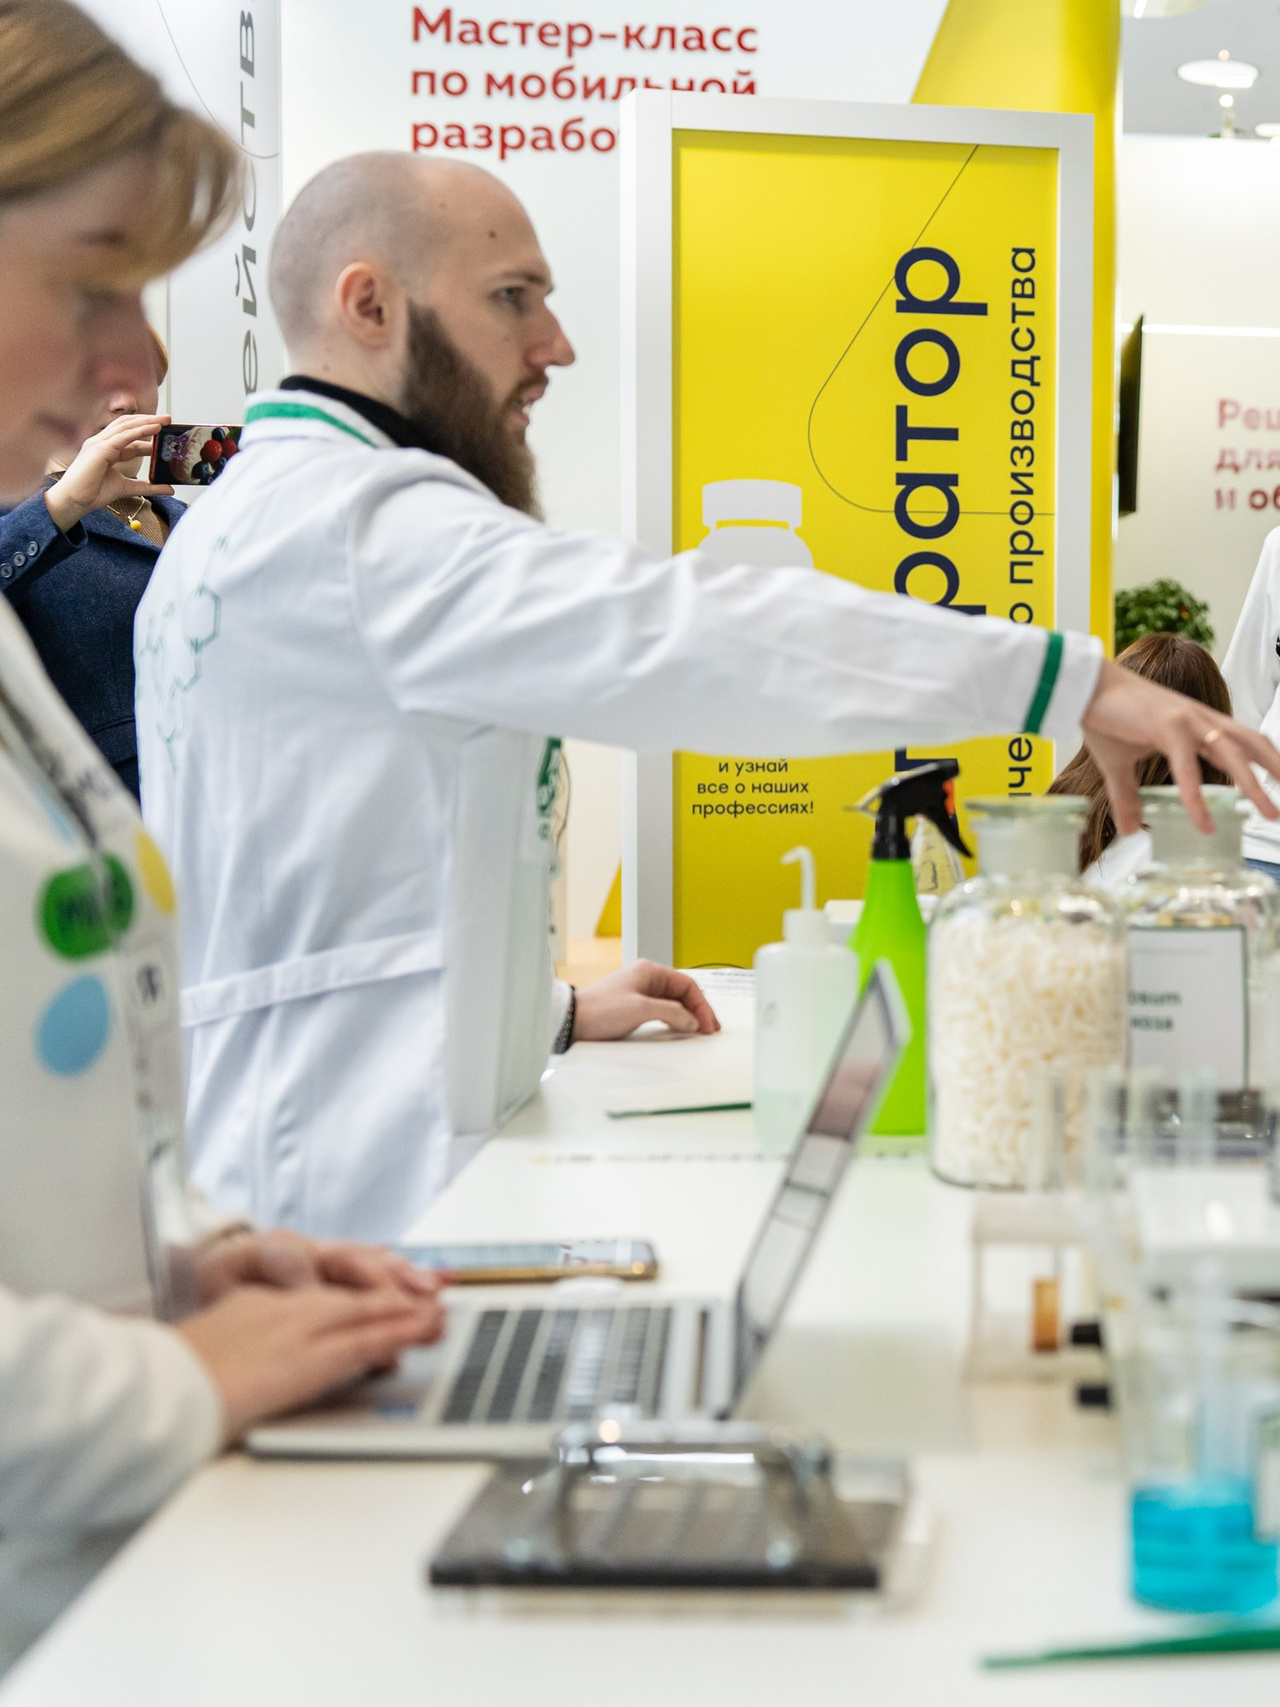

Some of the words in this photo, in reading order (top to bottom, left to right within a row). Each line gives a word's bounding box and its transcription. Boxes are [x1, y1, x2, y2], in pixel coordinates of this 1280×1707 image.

[411, 5, 758, 59] Мастер-класс
[411, 71, 468, 96] по
[411, 116, 621, 161] разрабо
[1008, 247, 1043, 585] производства
[718, 761, 729, 773] и
[735, 758, 788, 777] узнай
[697, 783, 729, 794] все
[735, 783, 746, 794] о
[751, 782, 809, 794] наших
[691, 800, 814, 819] профессиях!
